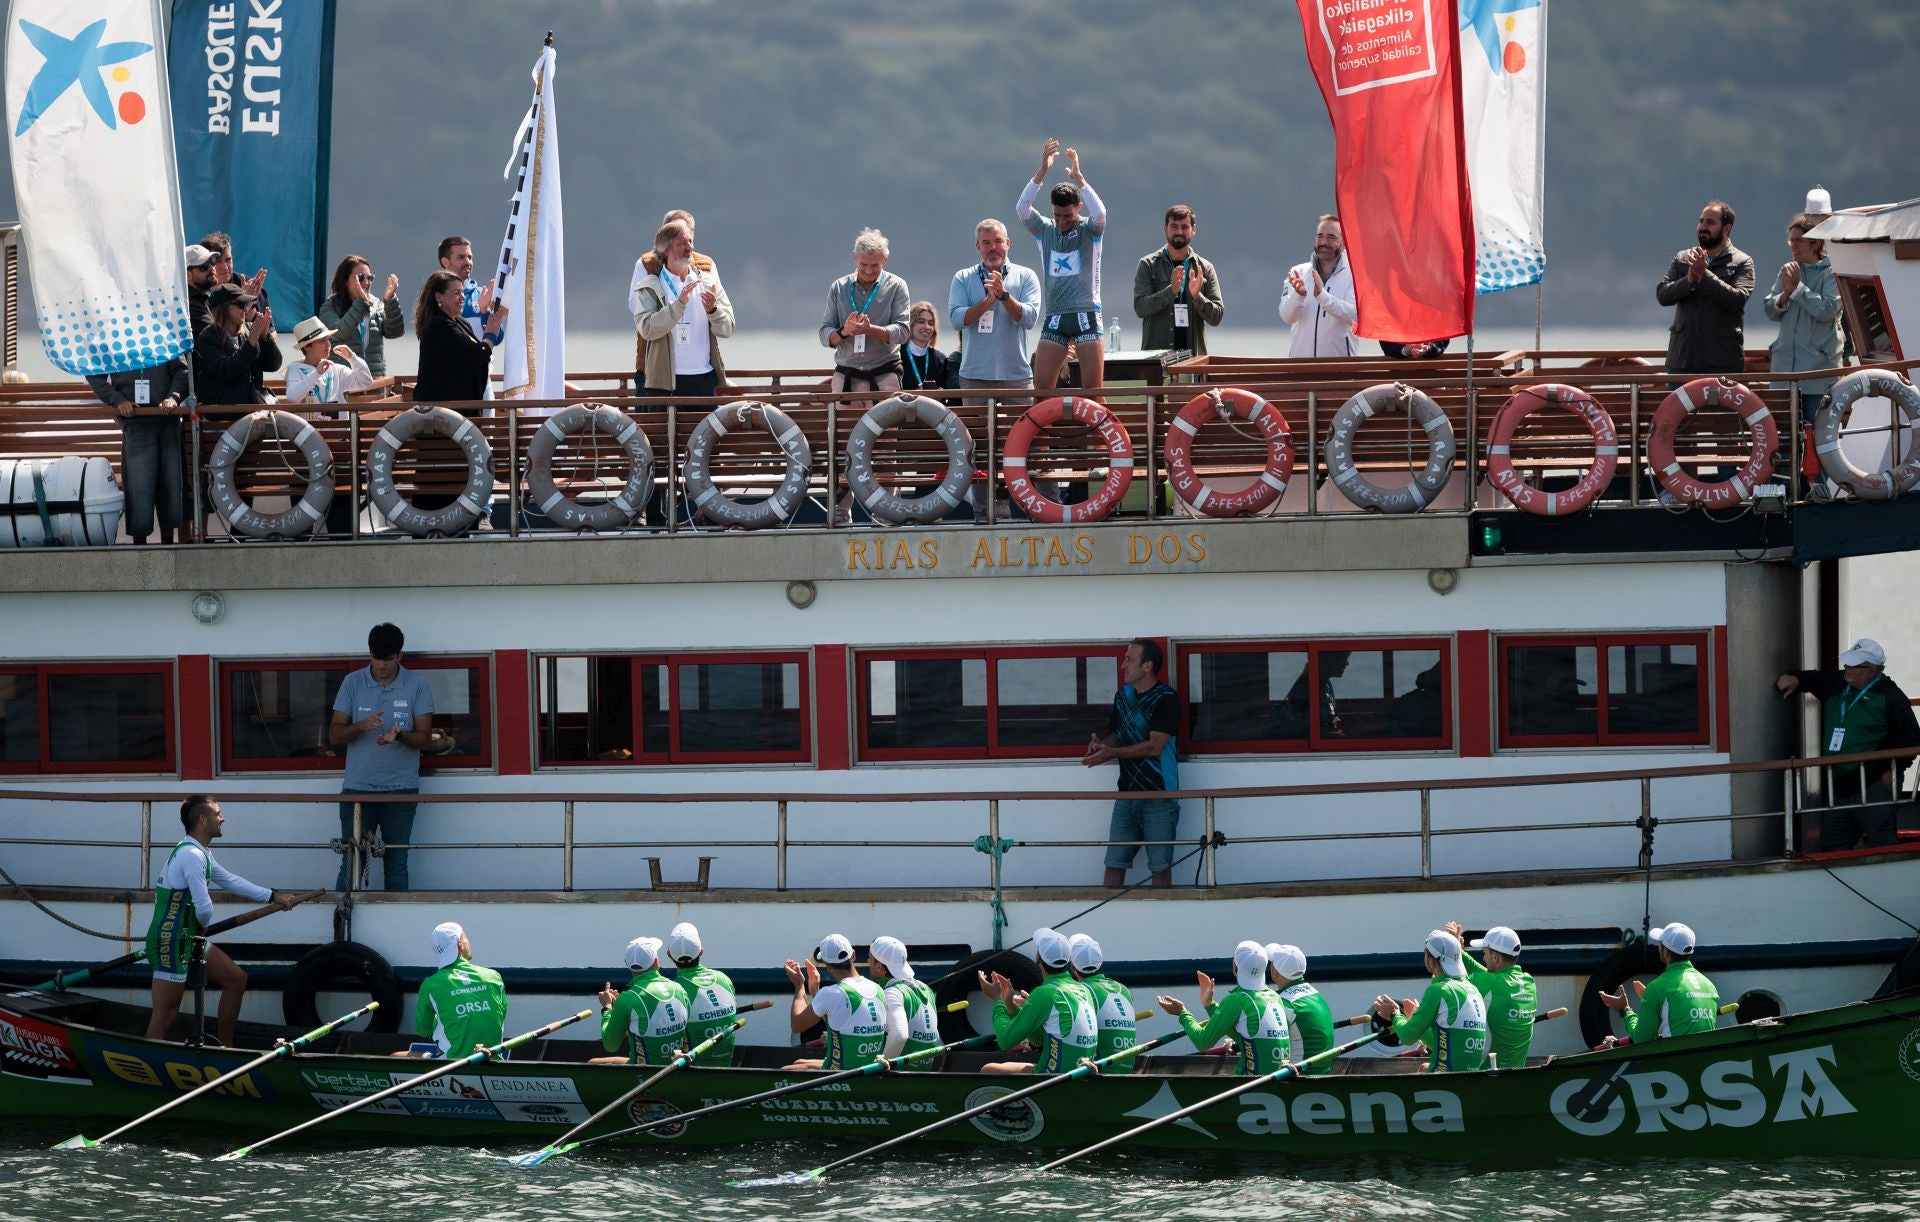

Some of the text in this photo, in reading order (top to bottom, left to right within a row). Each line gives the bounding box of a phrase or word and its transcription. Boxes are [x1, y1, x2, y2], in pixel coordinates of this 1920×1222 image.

[1090, 409, 1128, 454] ALTAS
[1259, 413, 1288, 462] ALTAS
[1334, 417, 1353, 472] ALTAS
[855, 438, 871, 483] RIAS
[949, 426, 966, 479] ALTAS
[1170, 447, 1193, 491] RIAS
[1427, 441, 1446, 485] RIAS
[1011, 477, 1047, 514] RIAS
[1497, 469, 1534, 504] RIAS
[1681, 484, 1730, 502] ALTAS
[846, 531, 1207, 570] RIAS ALTAS DOS
[450, 984, 487, 997] ECHEMAR
[455, 1000, 491, 1015] ORSA
[698, 1006, 735, 1021] ECHEMAR
[1690, 1007, 1713, 1020] ORSA
[15, 1026, 63, 1047] EUSKO LABEL
[19, 1036, 71, 1061] LIGA
[165, 1062, 262, 1098] BM
[491, 1080, 569, 1092] ENDANEA
[1550, 1043, 1859, 1137] ORSA
[416, 1101, 498, 1117] iparbus
[527, 1114, 571, 1123] Vertiz
[1236, 1089, 1466, 1135] aena
